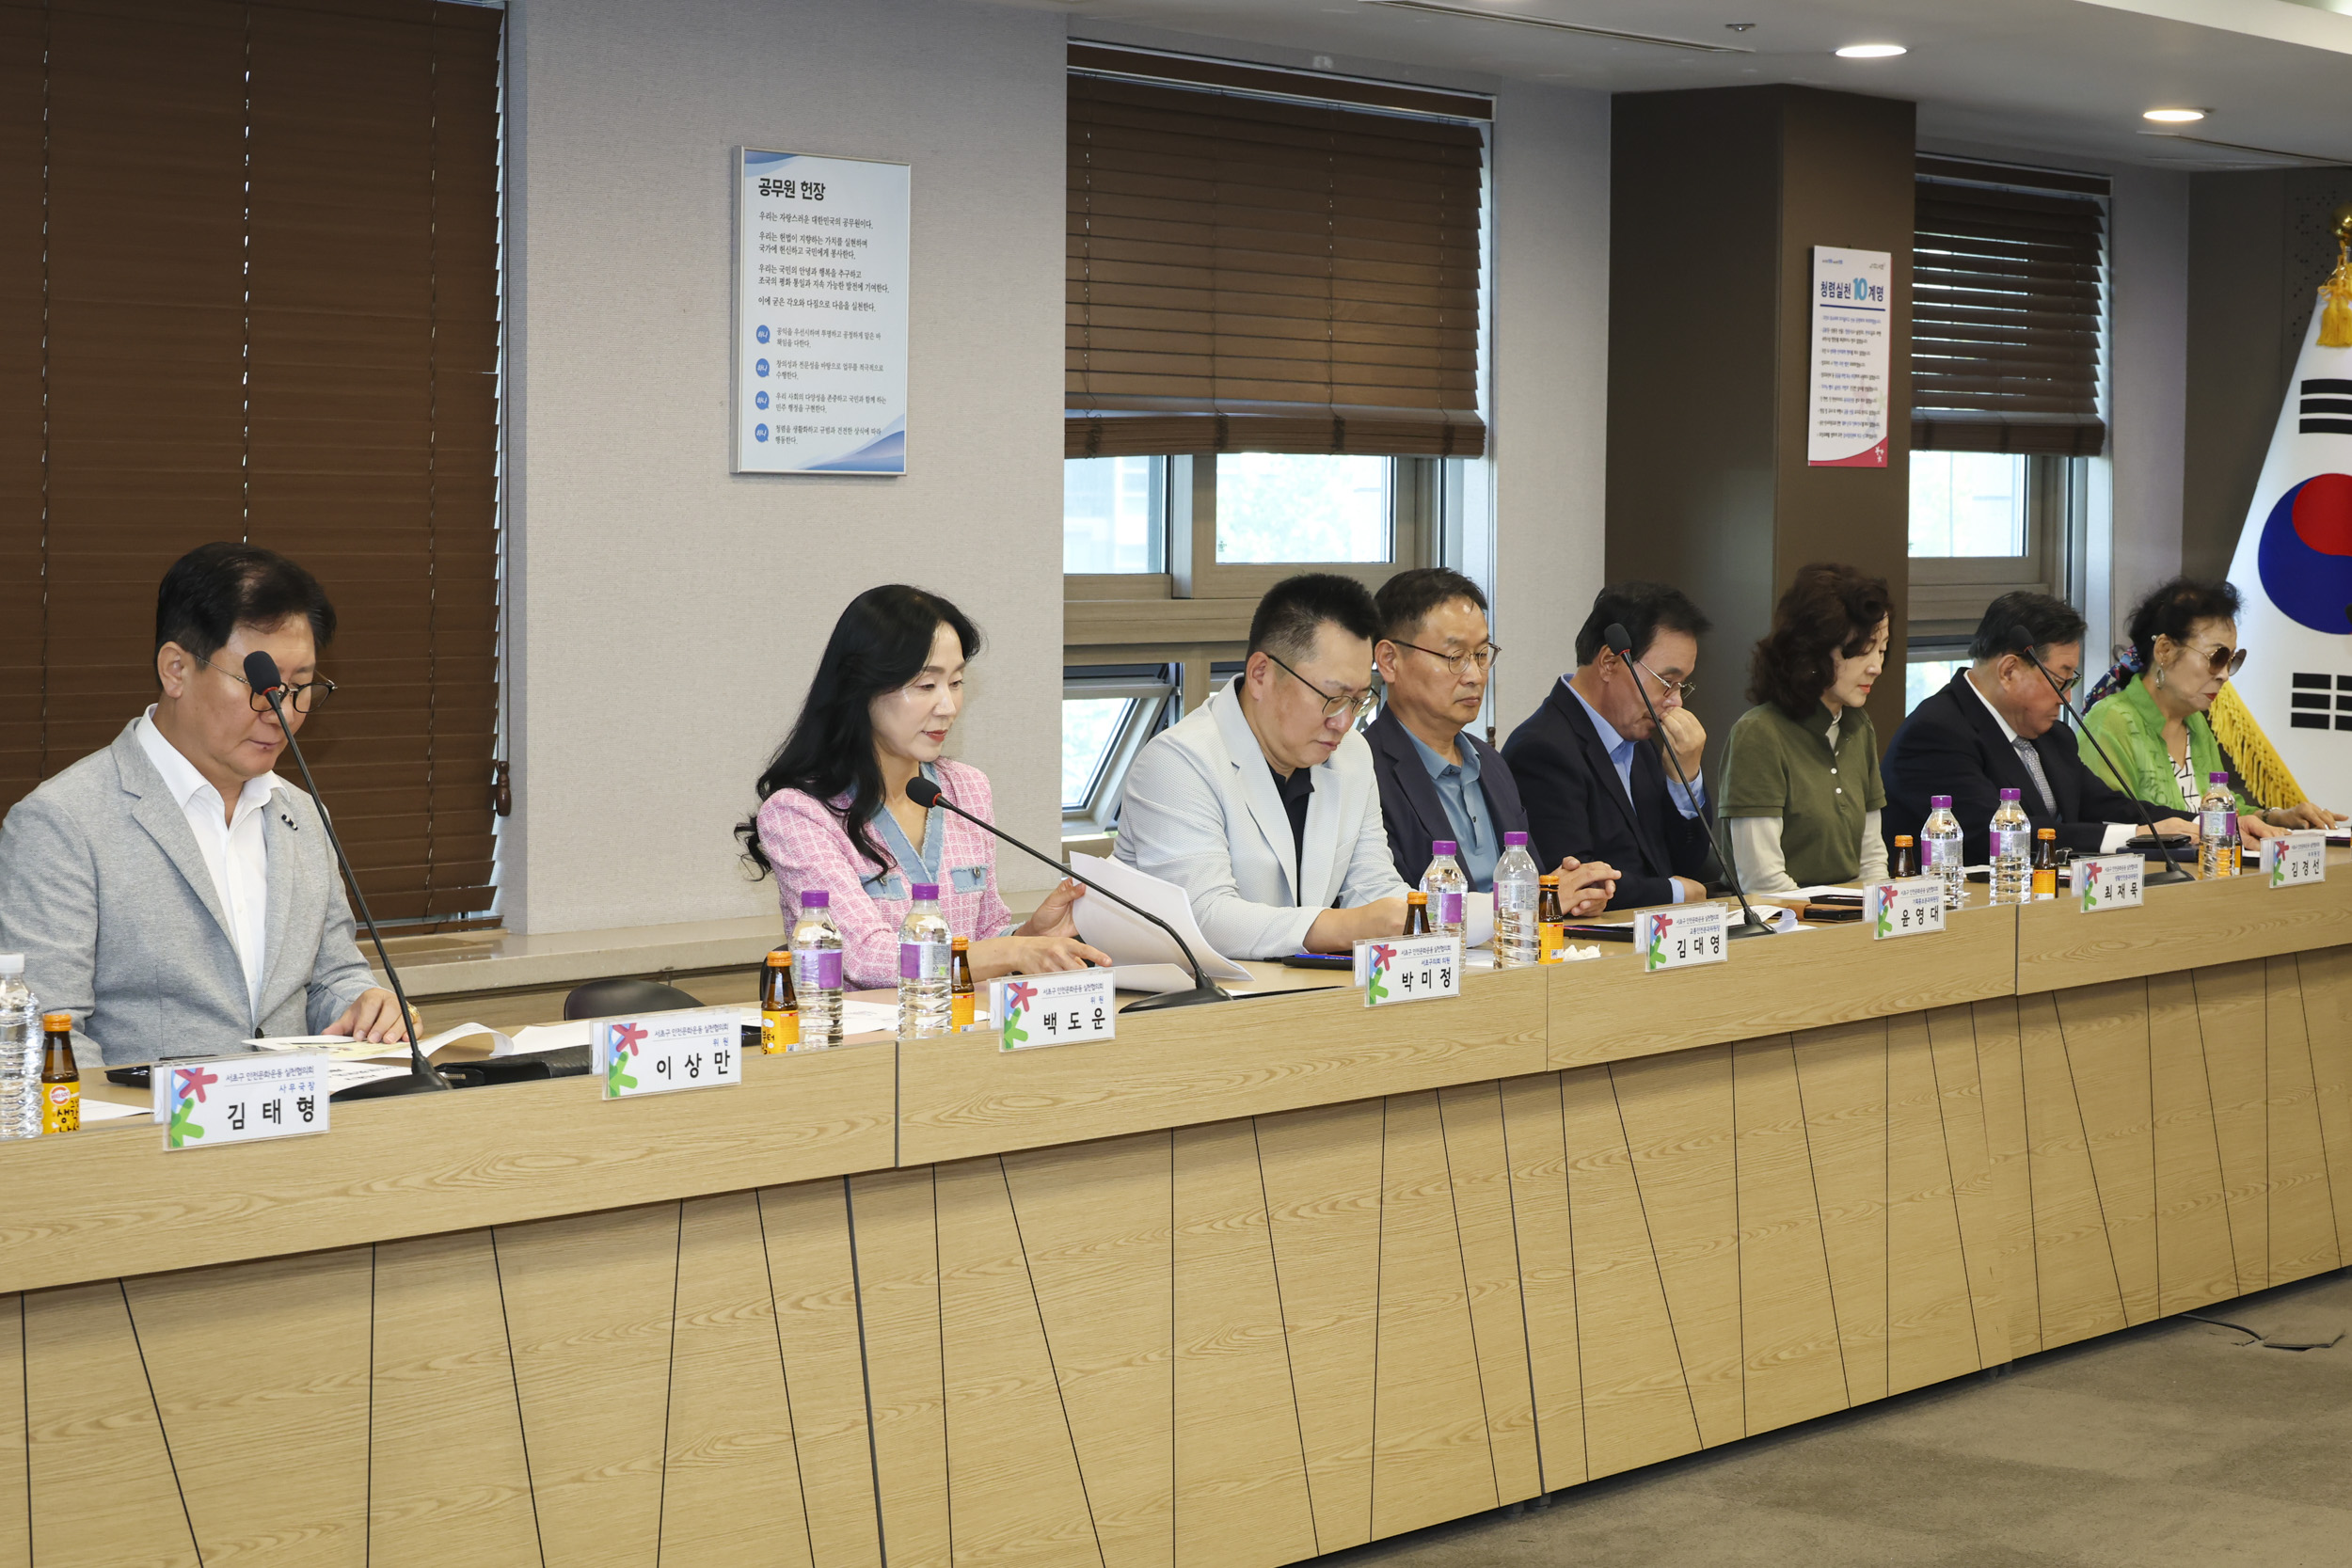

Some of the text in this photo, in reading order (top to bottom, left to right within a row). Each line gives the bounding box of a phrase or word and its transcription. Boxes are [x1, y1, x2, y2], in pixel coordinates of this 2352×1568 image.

[758, 178, 825, 200] 공무원 헌장
[759, 212, 873, 229] 우리는 자랑스러운 대한민국의 공무원이다.
[759, 231, 867, 248] 우리는 헌법이 지향하는 가치를 실현하며
[759, 245, 855, 260] 국가에 헌신하고 국민에게 봉사한다.
[758, 264, 862, 278] 우리는 국민의 안녕과 행복을 추구하고
[758, 277, 889, 293] 조국의 평화 통일과 지속 가능한 발전에 기여한다.
[1821, 281, 1851, 299] 청렴실천
[758, 296, 875, 311] 이에 굳은 각오와 다짐으로 다음을 실천한다.
[776, 372, 798, 380] 수행한다.
[226, 1073, 245, 1083] 서초구
[246, 1069, 282, 1081] 안전문화운동
[285, 1066, 314, 1077] 실천협의회
